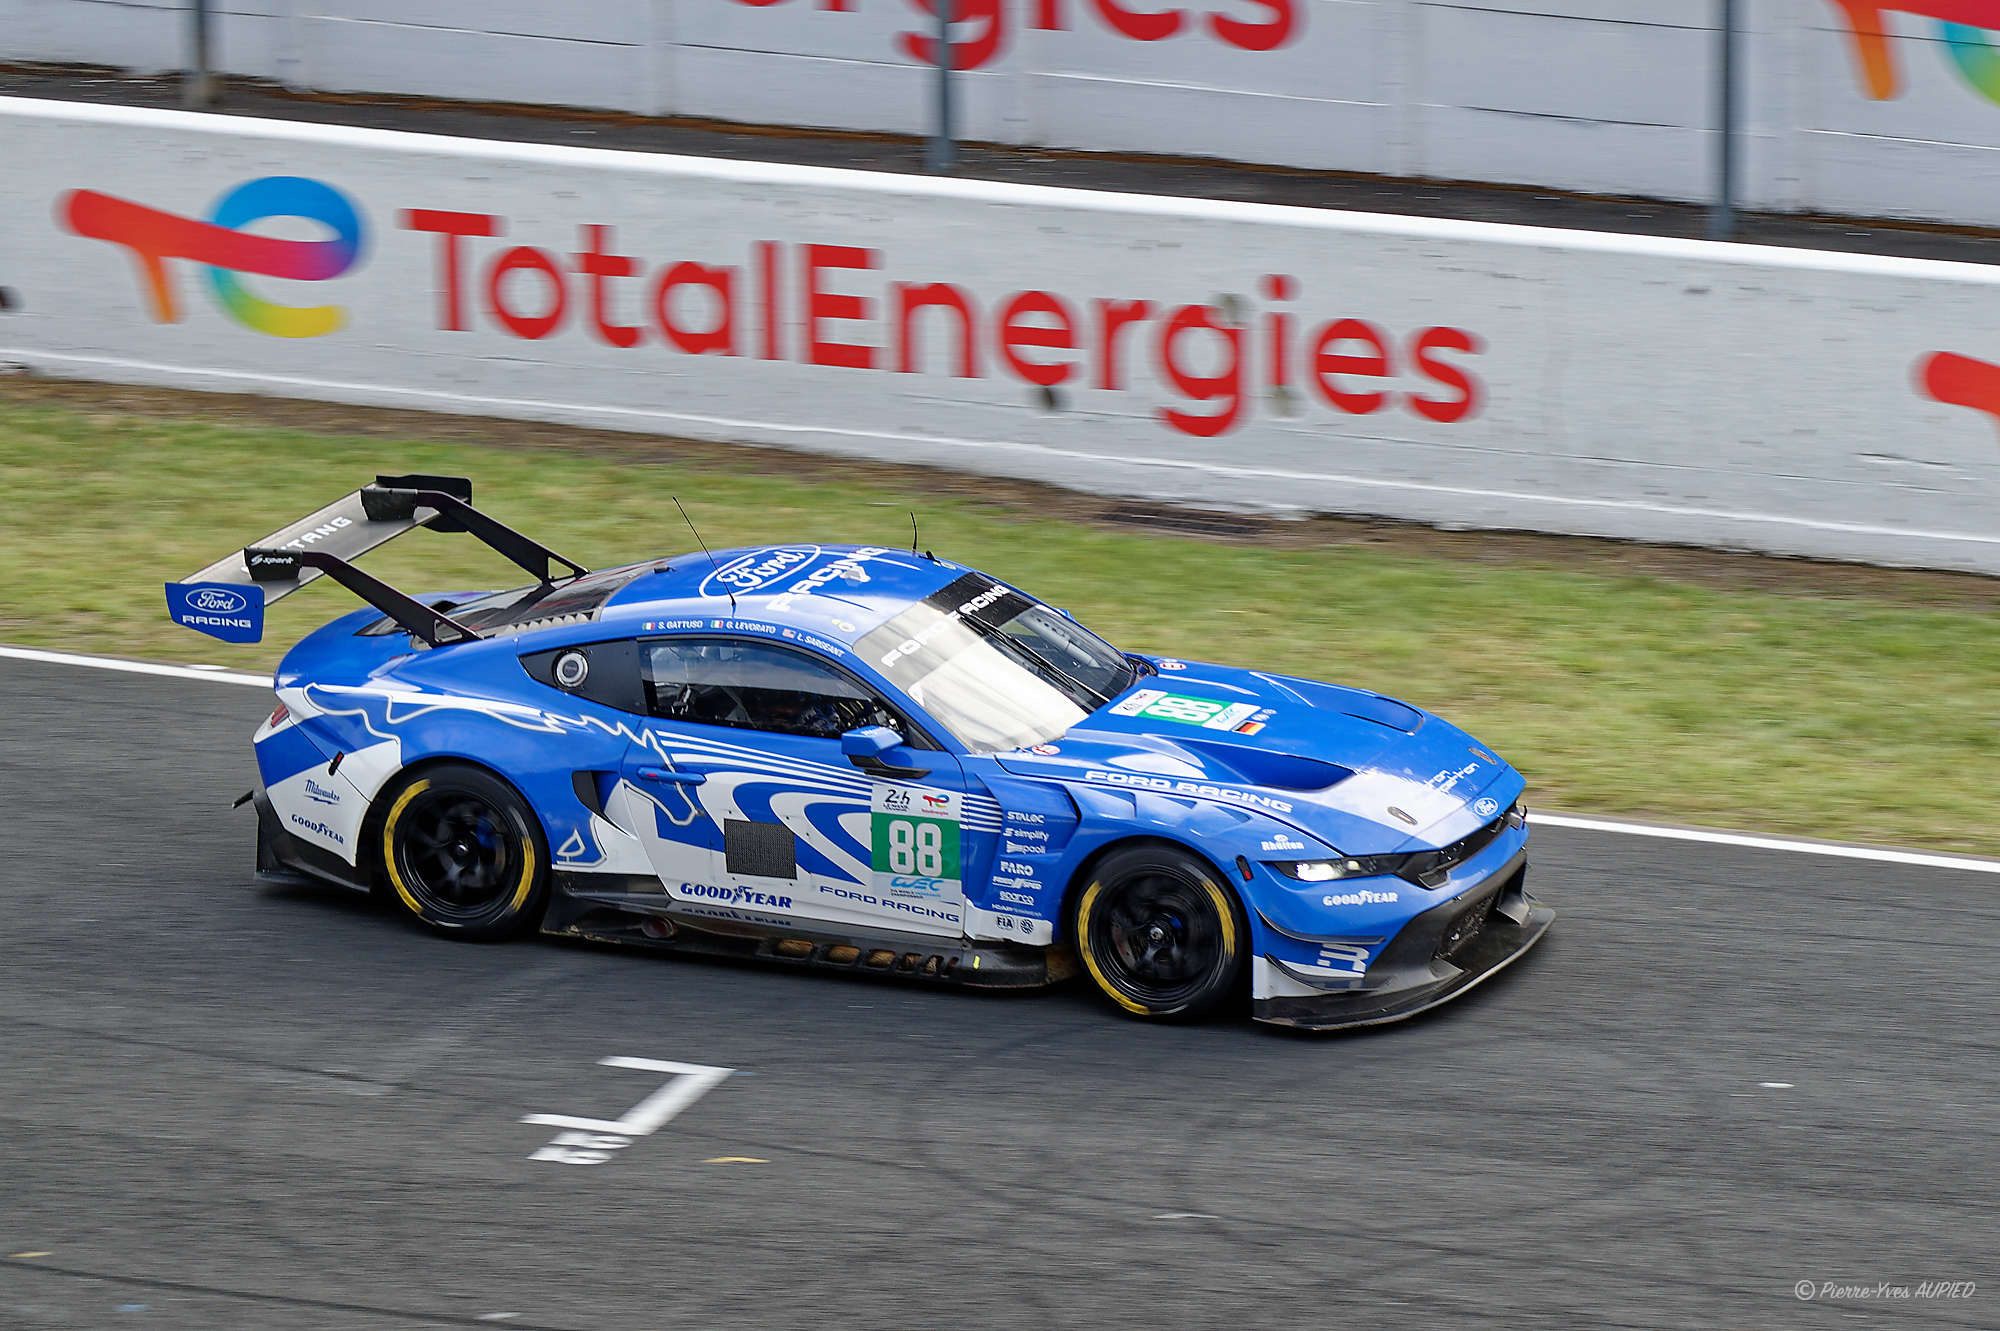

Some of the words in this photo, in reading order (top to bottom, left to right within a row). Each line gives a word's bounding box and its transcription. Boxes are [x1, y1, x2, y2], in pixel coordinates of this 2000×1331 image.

[398, 207, 1482, 437] TotalEnergies
[716, 551, 806, 588] Ford
[197, 591, 234, 610] Ford
[182, 615, 252, 629] RACING
[667, 620, 704, 630] GATTUSO
[735, 622, 777, 635] LEVORATO
[1145, 696, 1224, 723] 88
[1084, 770, 1171, 789] FORD
[1176, 782, 1293, 814] RACING
[1014, 828, 1049, 842] simplify
[889, 820, 942, 877] 88
[1000, 860, 1034, 876] FARO
[890, 876, 944, 891] WEC
[680, 882, 792, 909] GOODYEAR
[820, 885, 877, 904] FORD
[881, 898, 960, 923] RACING
[997, 916, 1013, 928] FIA
